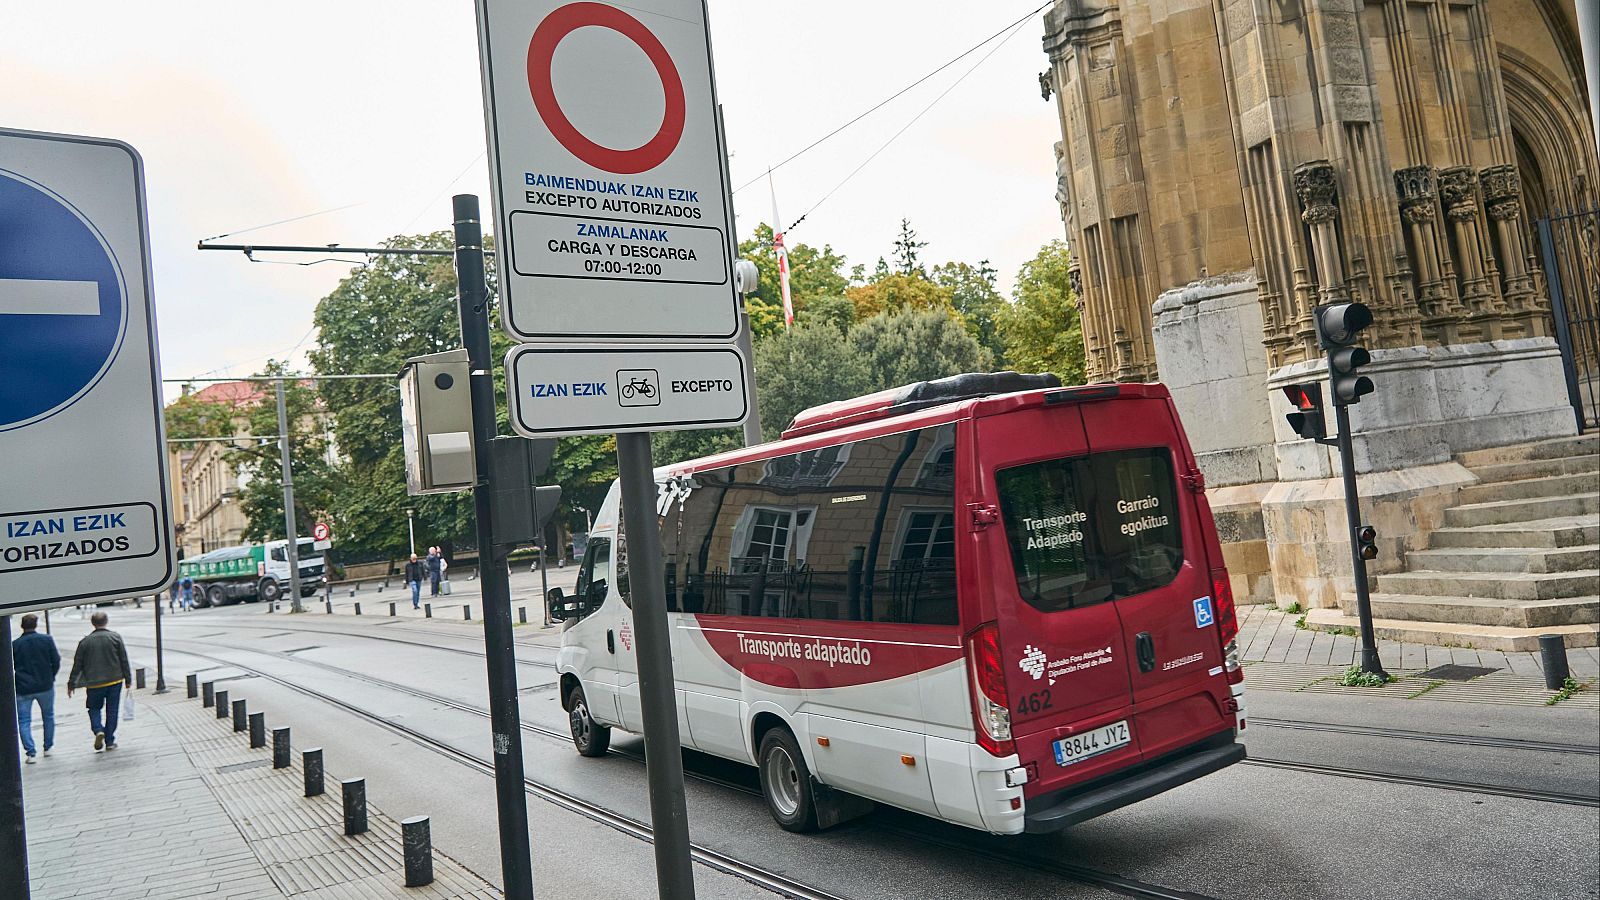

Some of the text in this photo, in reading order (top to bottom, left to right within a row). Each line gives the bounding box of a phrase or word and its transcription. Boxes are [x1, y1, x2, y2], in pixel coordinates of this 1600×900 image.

[524, 172, 700, 203] BAIMENDUAK IZAN EZIK
[525, 190, 702, 220] EXCEPTO AUTORIZADOS
[576, 223, 669, 242] ZAMALANAK
[547, 239, 697, 261] CARGA Y DESCARGA
[584, 260, 662, 275] 07:00-12:00
[530, 382, 608, 398] IZAN EZIK
[671, 379, 733, 393] EXCEPTO
[1116, 495, 1159, 514] Garraio
[7, 512, 126, 538] IZAN EZIK
[1023, 511, 1087, 531] Transporte
[1120, 515, 1168, 537] egokitua
[0, 535, 130, 563] ORIZADOS
[1027, 529, 1083, 550] Adaptado
[737, 633, 871, 667] Transporte adaptado
[1017, 688, 1053, 715] 462
[1064, 724, 1127, 757] 8844 JYZ
